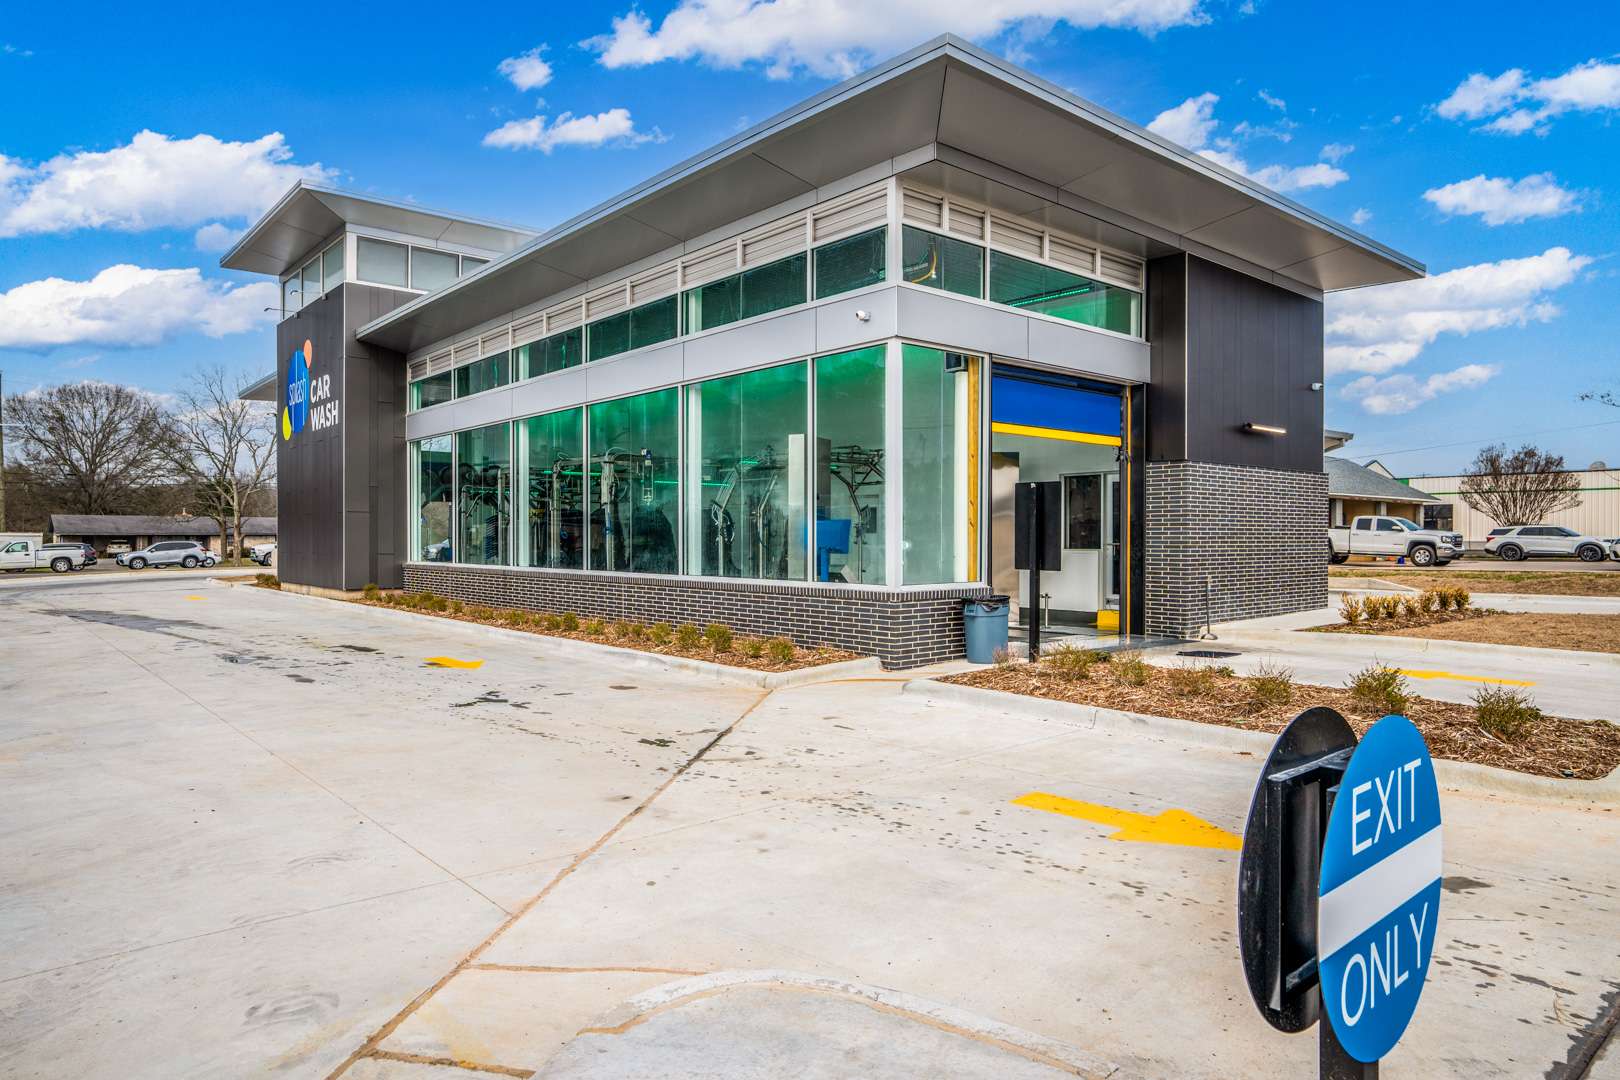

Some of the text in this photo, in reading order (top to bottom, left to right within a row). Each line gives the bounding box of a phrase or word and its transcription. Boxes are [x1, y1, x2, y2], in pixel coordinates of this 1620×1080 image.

[310, 374, 331, 404] CAR
[310, 400, 339, 431] WASH
[1352, 758, 1421, 856] EXIT
[1341, 902, 1428, 1027] ONLY
